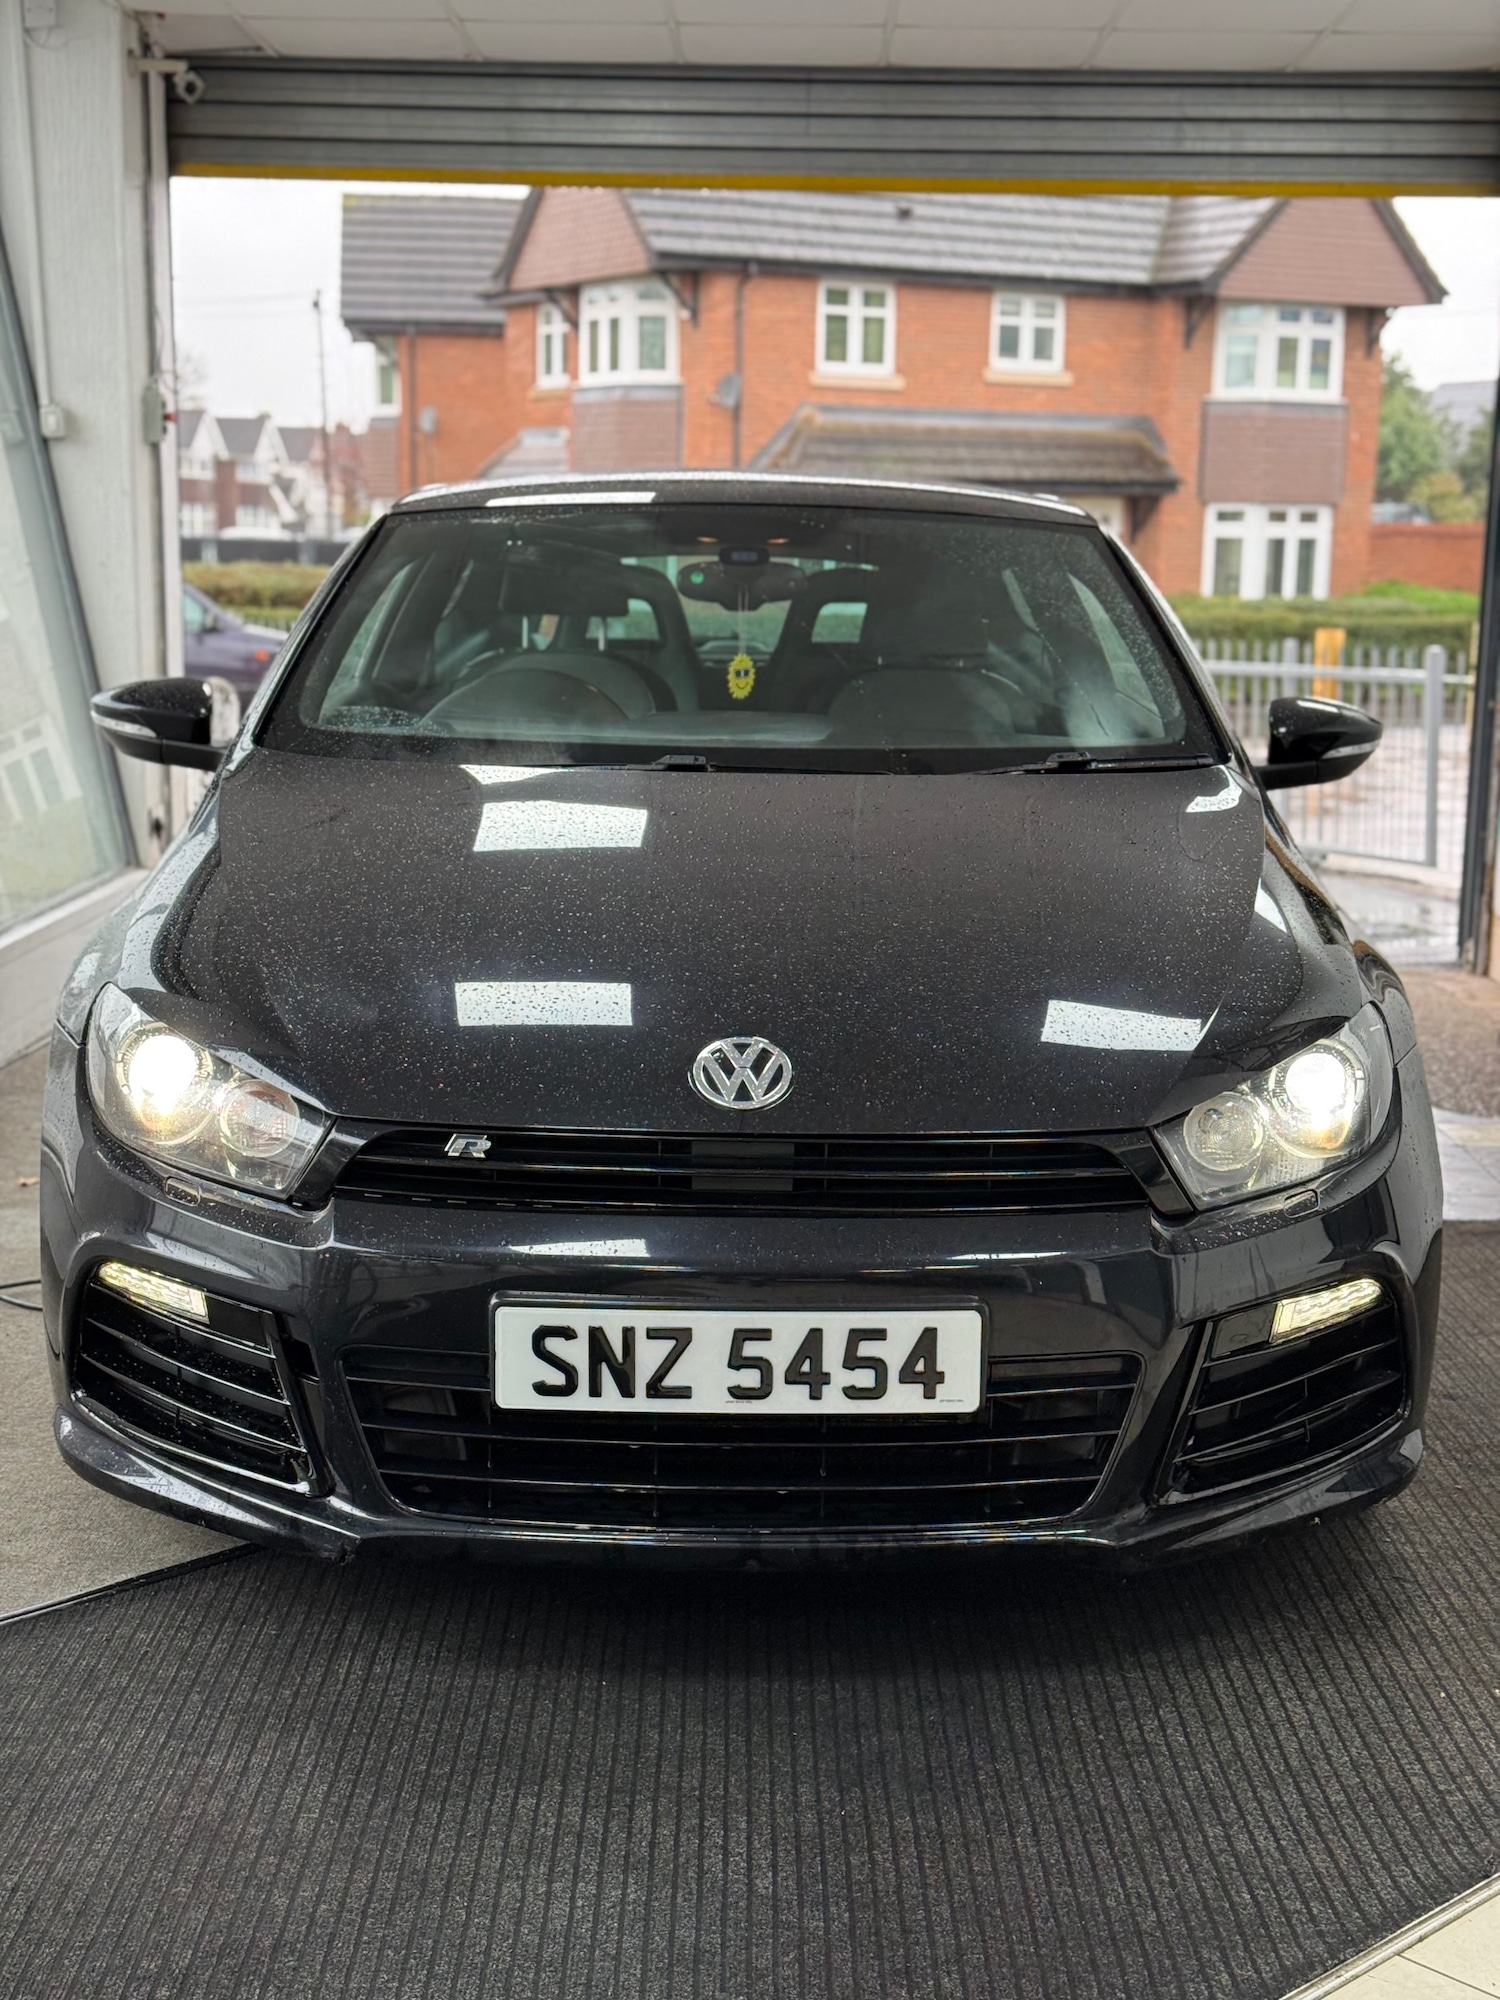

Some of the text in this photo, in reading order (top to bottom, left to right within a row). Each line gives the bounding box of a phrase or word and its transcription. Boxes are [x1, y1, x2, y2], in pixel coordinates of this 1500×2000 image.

[693, 1037, 792, 1110] VW
[444, 1133, 491, 1158] R
[531, 1325, 945, 1400] SNZ 5454
